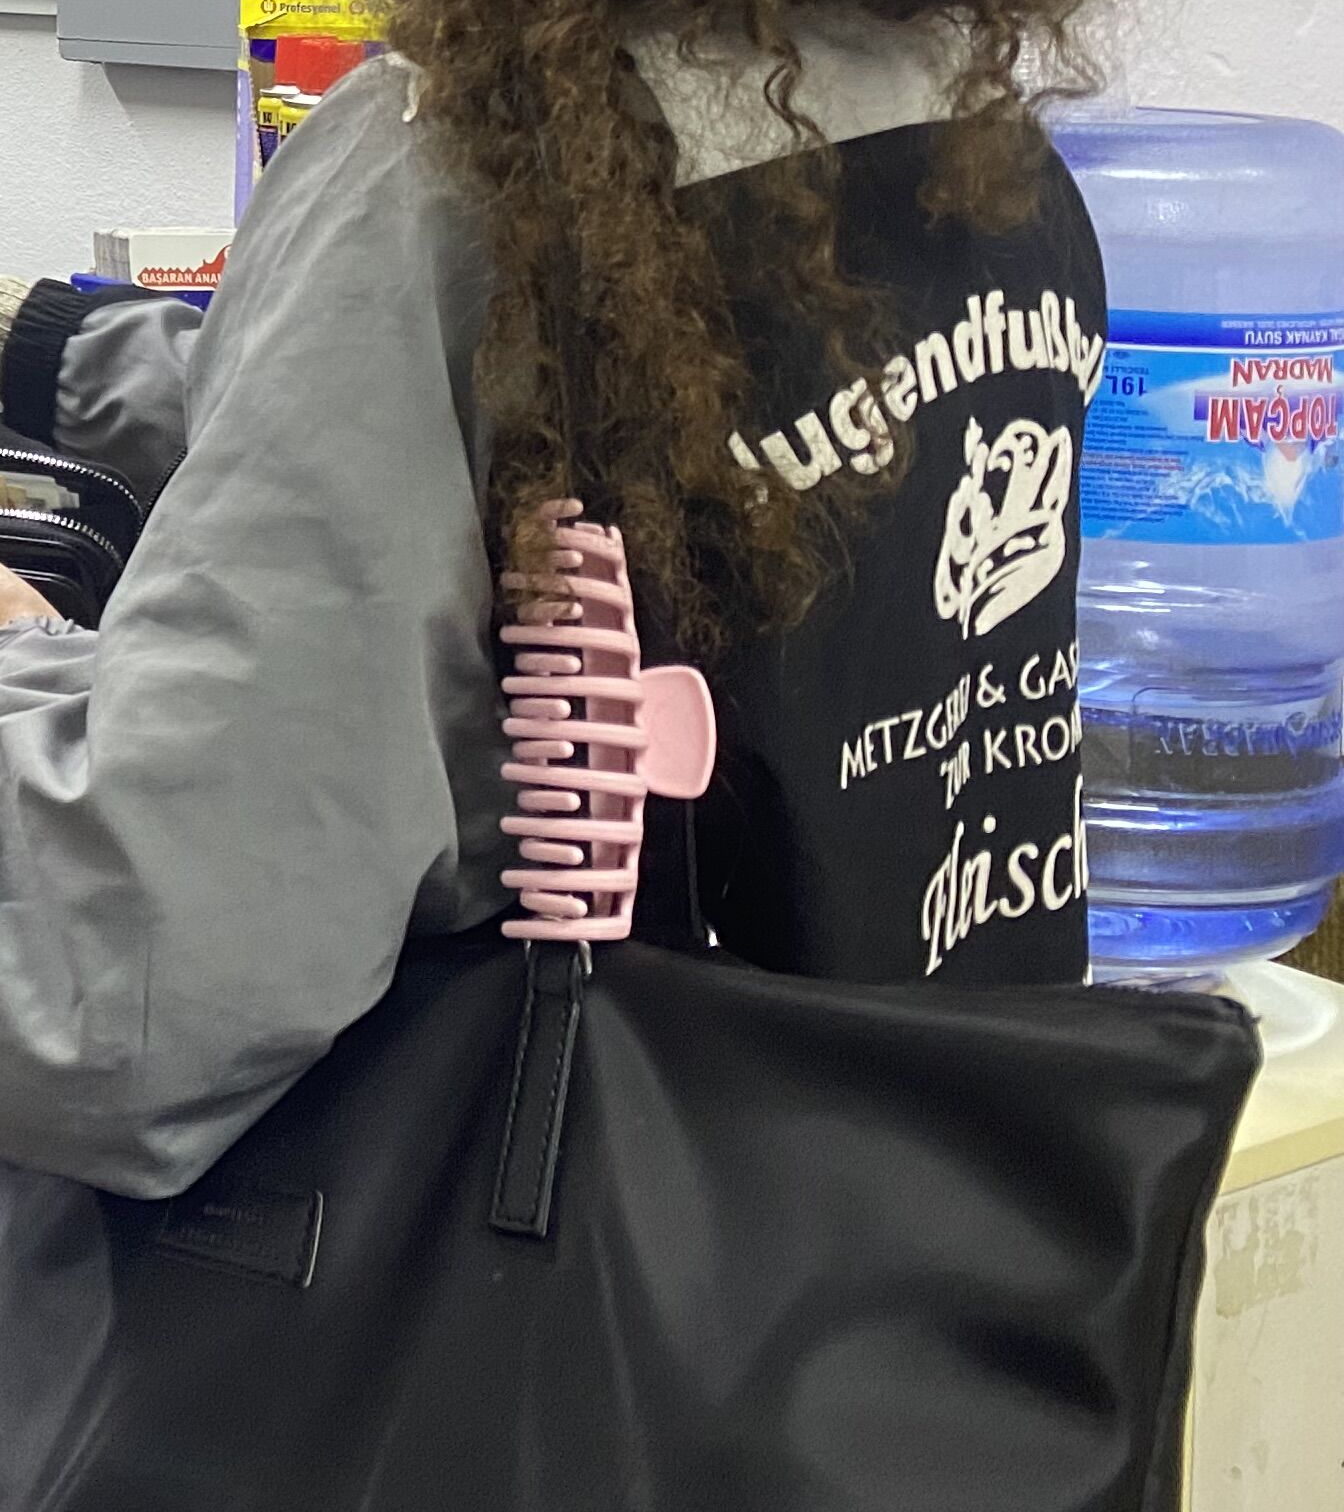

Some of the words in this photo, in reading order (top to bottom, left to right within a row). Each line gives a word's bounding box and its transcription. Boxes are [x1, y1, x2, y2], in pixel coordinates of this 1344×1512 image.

[279, 1, 342, 16] Profesyonel
[141, 272, 193, 285] BAŞARAN
[1244, 330, 1283, 345] SUYU
[1285, 330, 1328, 345] KAYNAK
[1231, 356, 1333, 387] MADRAN
[1208, 385, 1338, 442] TOPÇAM
[976, 662, 1007, 709] &
